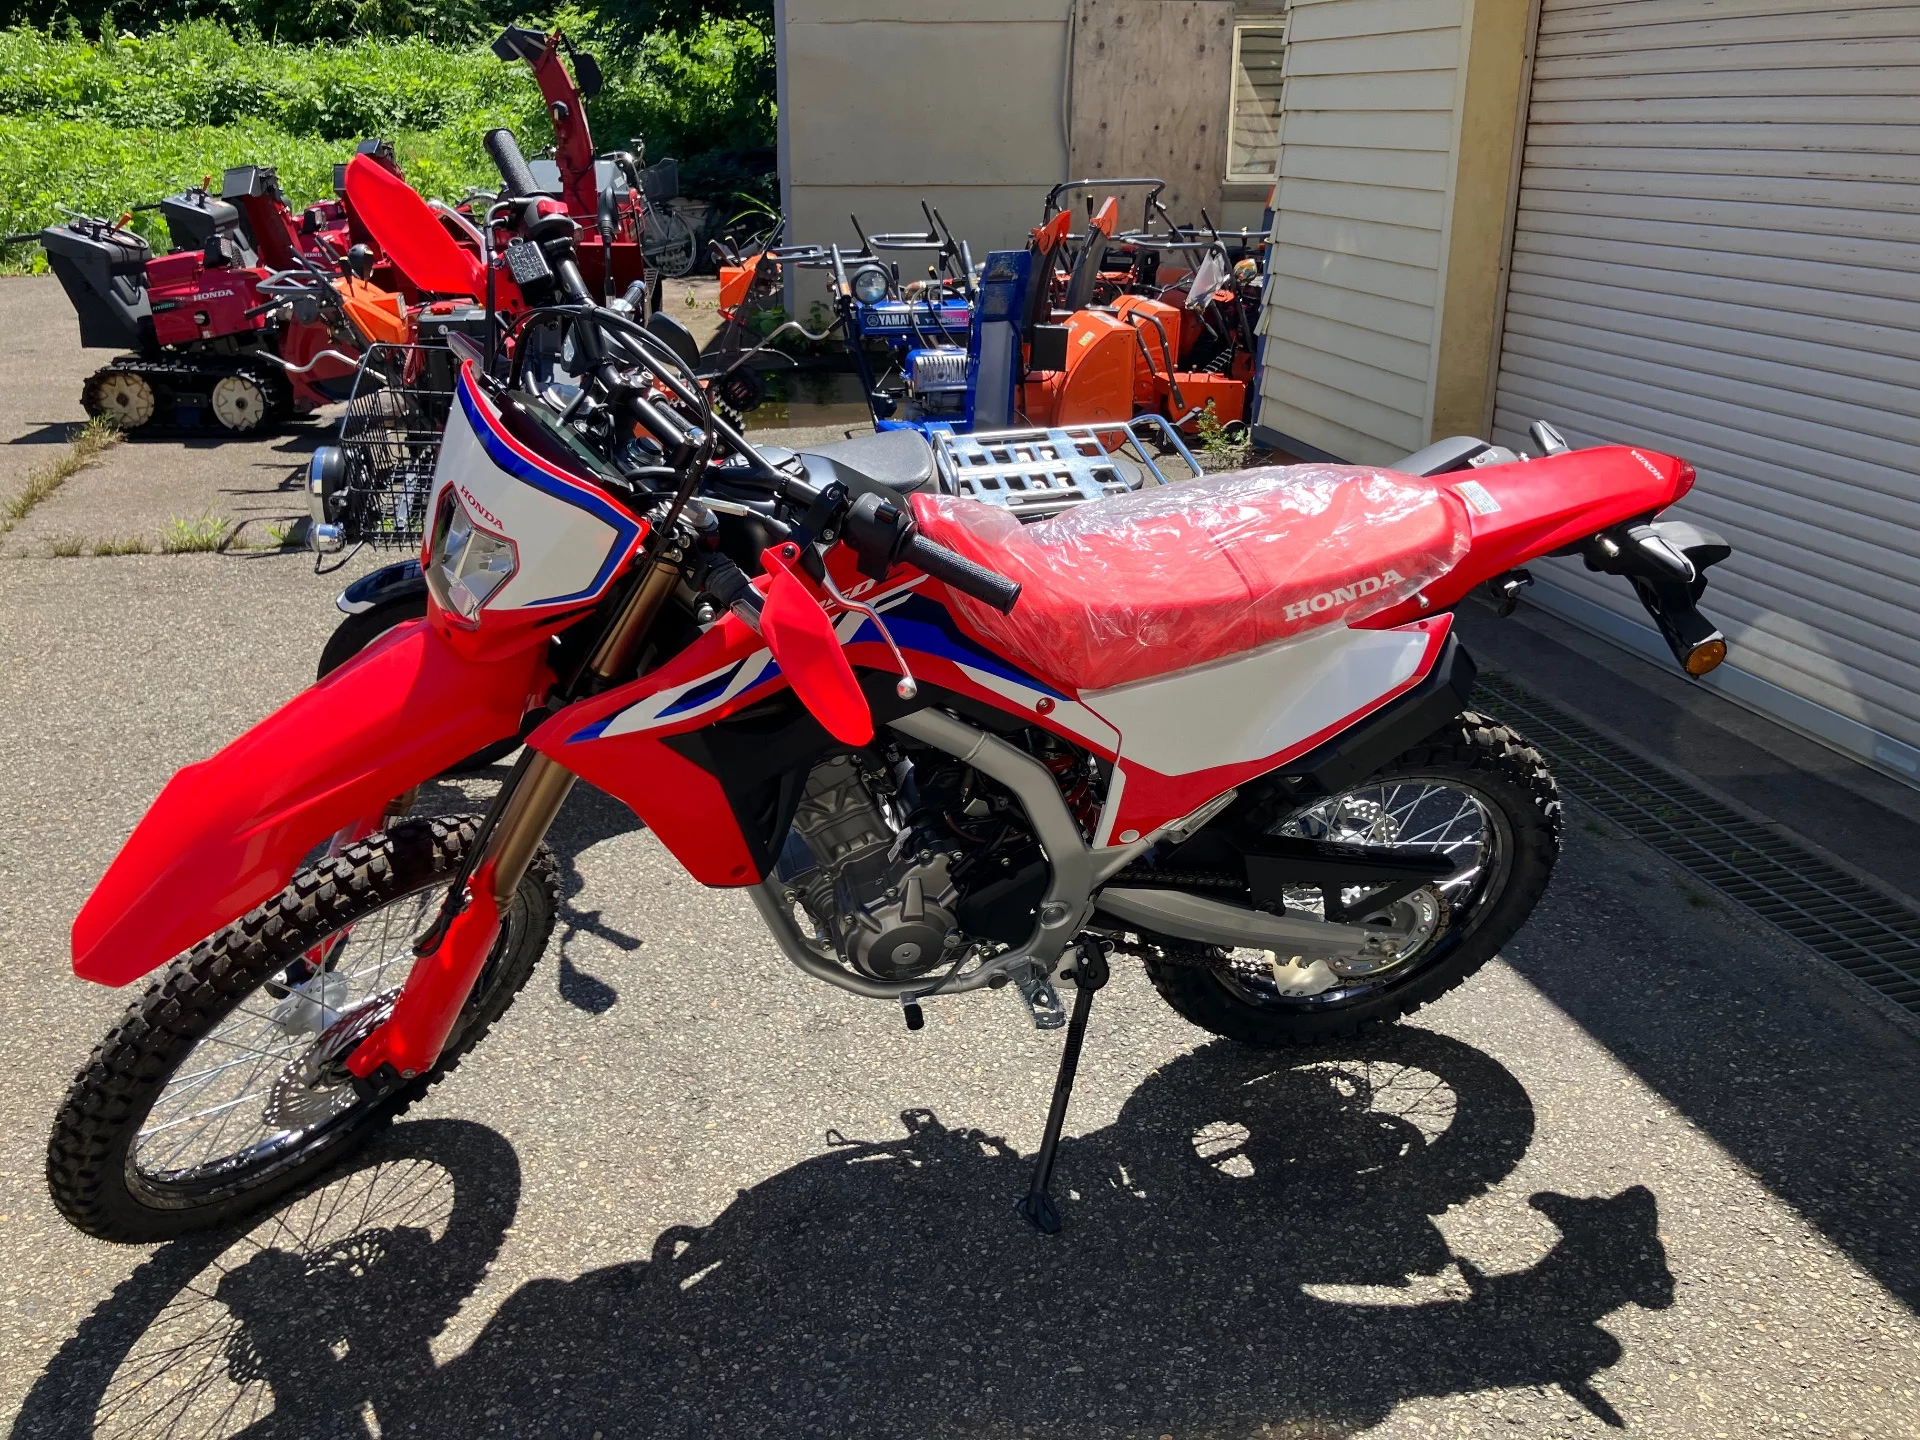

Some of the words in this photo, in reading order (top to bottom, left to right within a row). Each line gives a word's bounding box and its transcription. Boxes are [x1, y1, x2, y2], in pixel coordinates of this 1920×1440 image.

[193, 289, 234, 302] HONDA
[1631, 450, 1664, 480] HONDA
[460, 484, 504, 531] HONDA
[1282, 569, 1406, 622] HONDA
